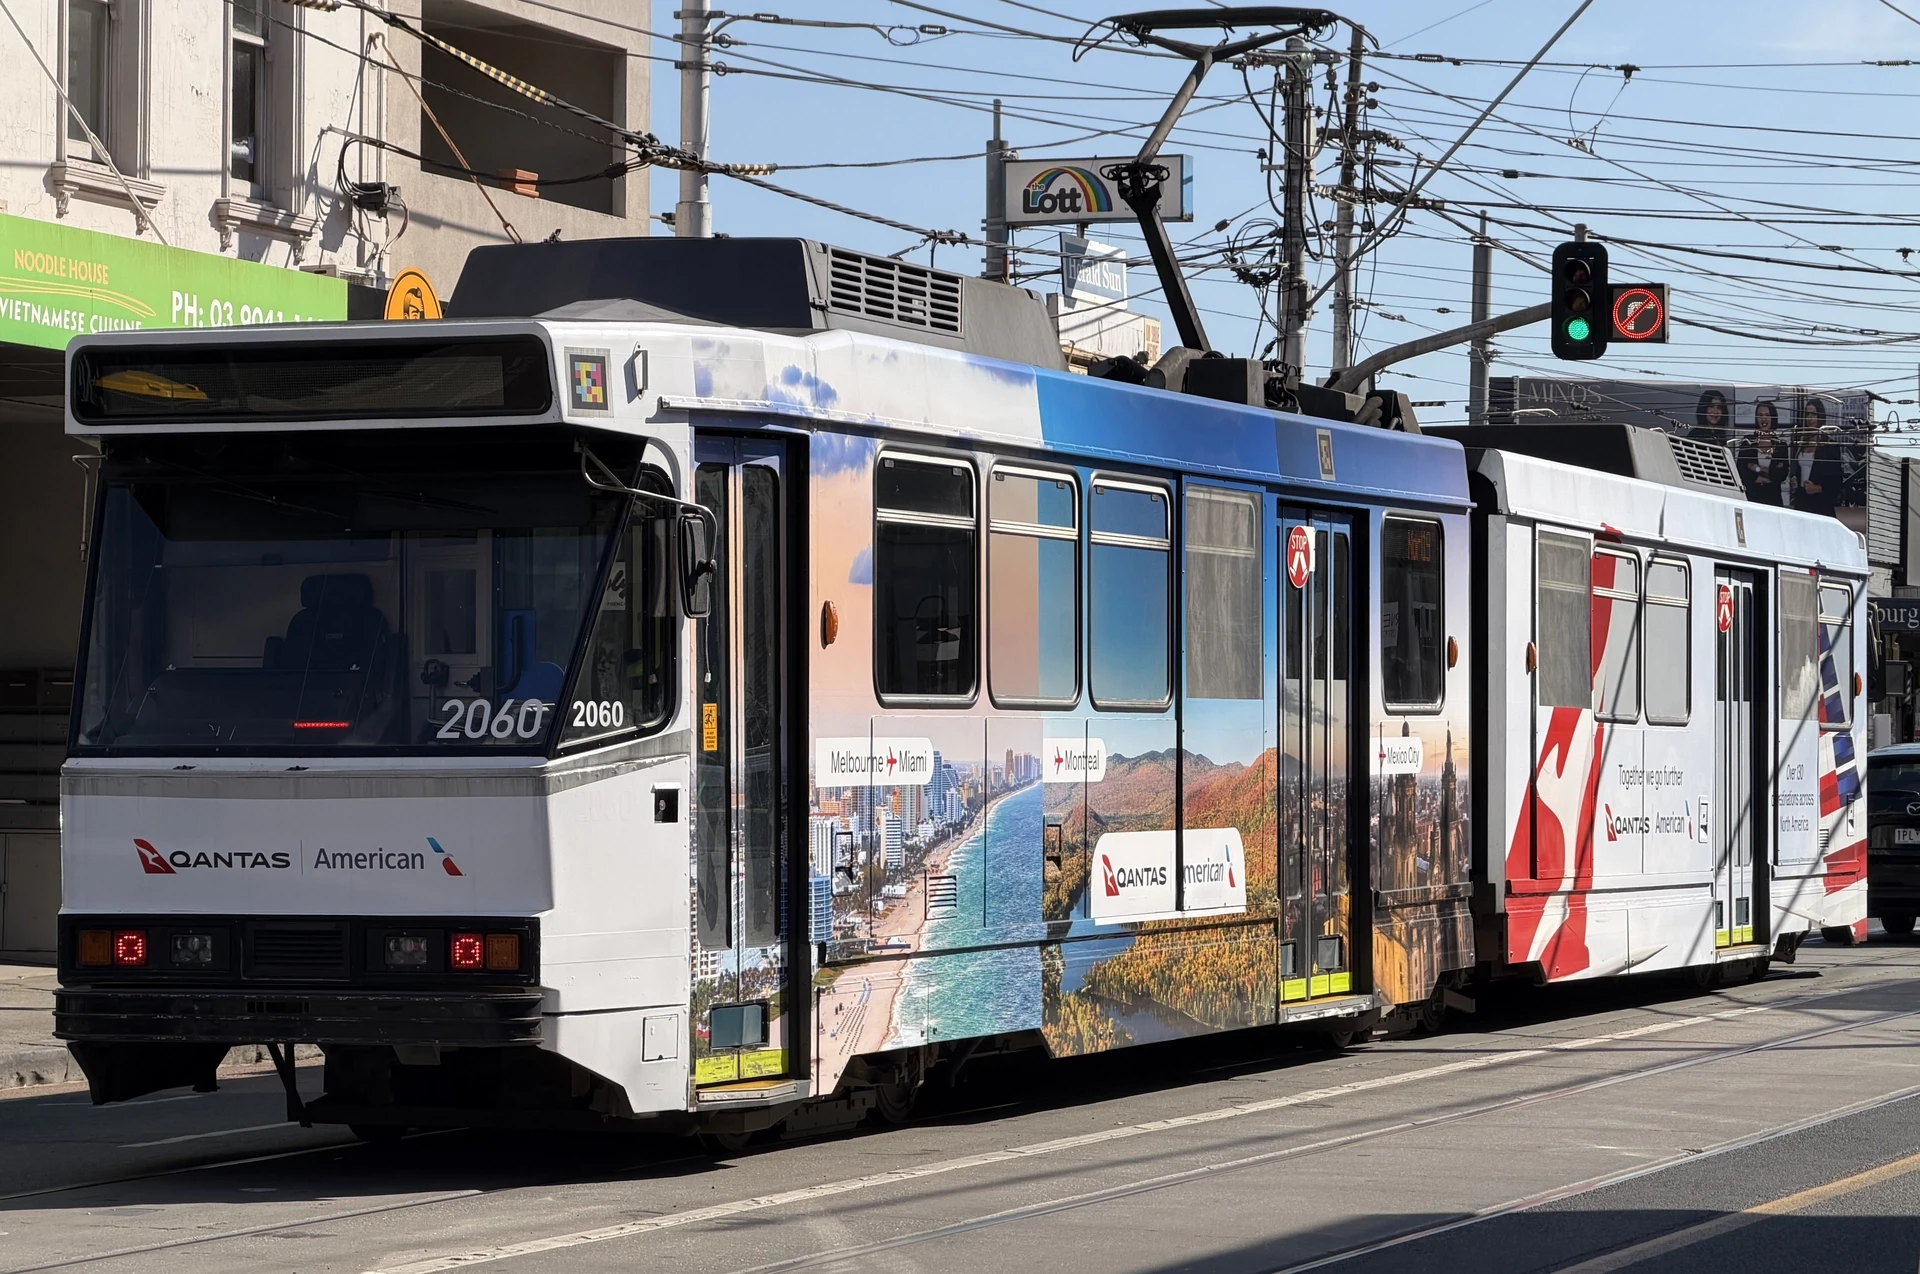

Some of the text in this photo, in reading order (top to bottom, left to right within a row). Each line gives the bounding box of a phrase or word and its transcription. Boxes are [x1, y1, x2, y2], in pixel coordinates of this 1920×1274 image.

[1022, 187, 1082, 214] Lott
[14, 248, 109, 285] NOODLE HOUSE
[1068, 256, 1123, 292] Herald Sun
[0, 297, 85, 333] VIETNAMESE
[172, 290, 204, 328] PH:
[210, 299, 234, 328] 03
[1528, 382, 1602, 405] MINOS
[1291, 534, 1308, 551] STOP
[436, 698, 544, 739] 2060
[572, 700, 624, 728] 2060
[830, 750, 927, 774] Melbourne Miami
[1387, 746, 1420, 767] Mexico City
[1618, 764, 1684, 790] Together we go further
[1771, 790, 1799, 807] stinations
[1615, 811, 1685, 835] QANTAS American
[169, 847, 425, 870] QANTAS American
[1117, 857, 1224, 888] QANTAS merican
